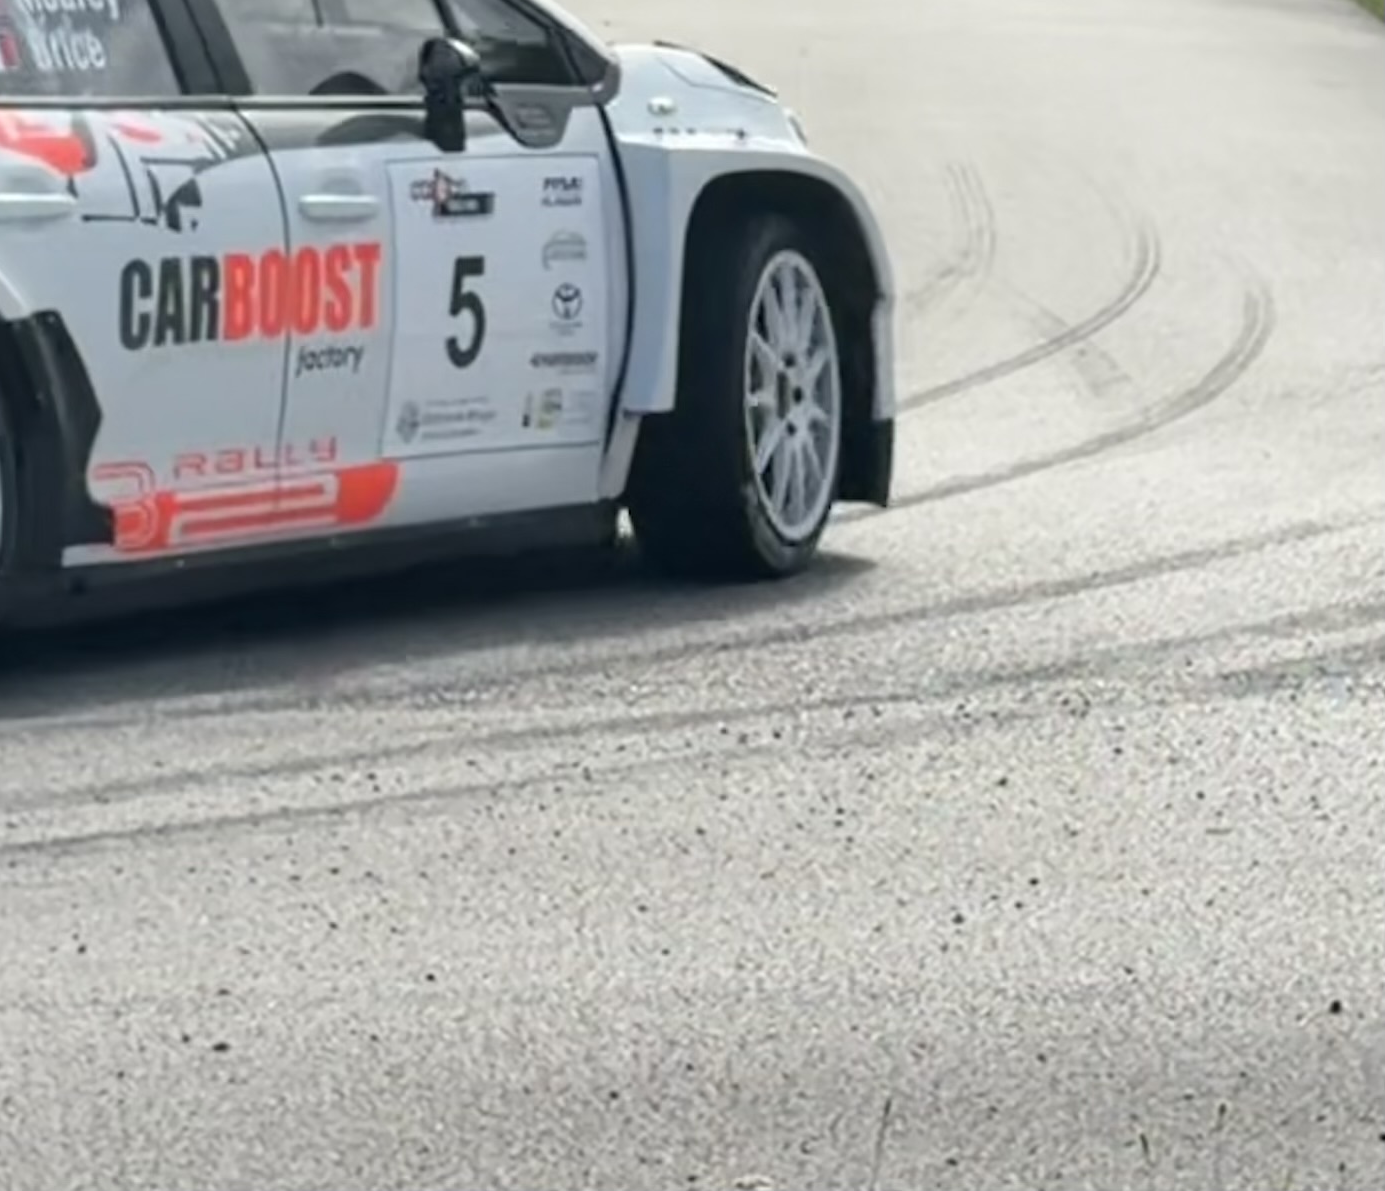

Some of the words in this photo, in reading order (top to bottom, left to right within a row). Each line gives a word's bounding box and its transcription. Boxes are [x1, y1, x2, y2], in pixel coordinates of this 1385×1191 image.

[119, 241, 382, 352] CARBOOST
[445, 256, 486, 368] 5
[296, 346, 364, 378] factory
